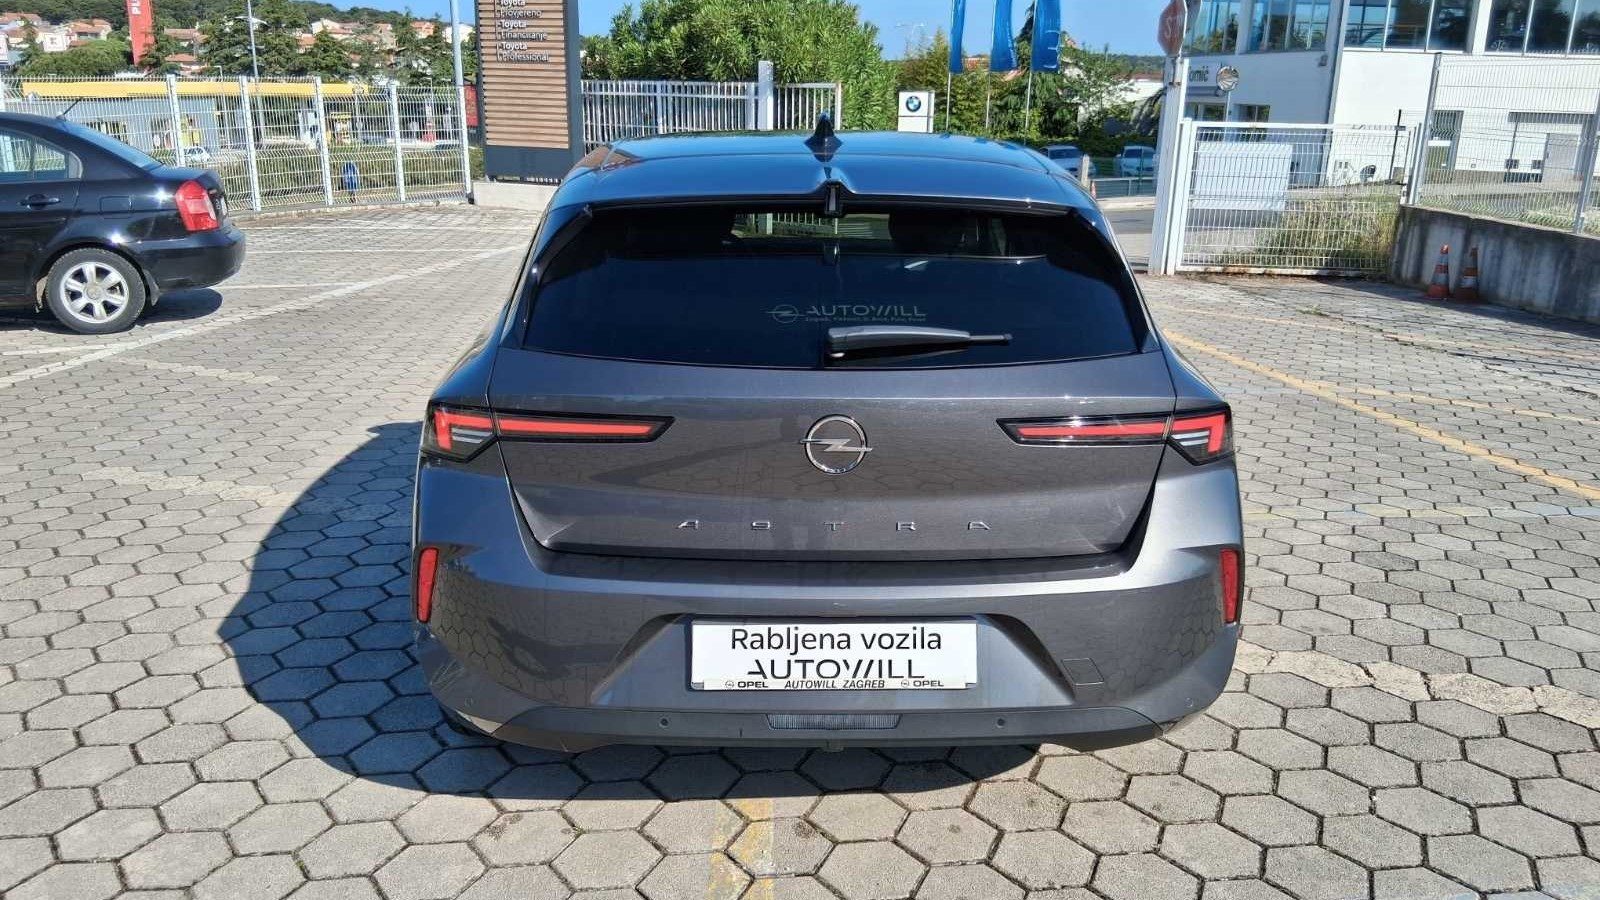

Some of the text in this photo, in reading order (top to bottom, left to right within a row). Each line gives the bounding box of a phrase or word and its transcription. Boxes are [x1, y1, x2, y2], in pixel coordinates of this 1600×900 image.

[500, 20, 527, 29] Toyota
[502, 41, 528, 51] Toyota
[503, 50, 549, 62] Professional
[806, 305, 927, 316] AUTOWILL
[731, 626, 942, 656] Rabljena vozila
[747, 659, 925, 680] AUTOWILL
[737, 679, 944, 689] OPEL AUTOWILL ZAGREB OPEL
